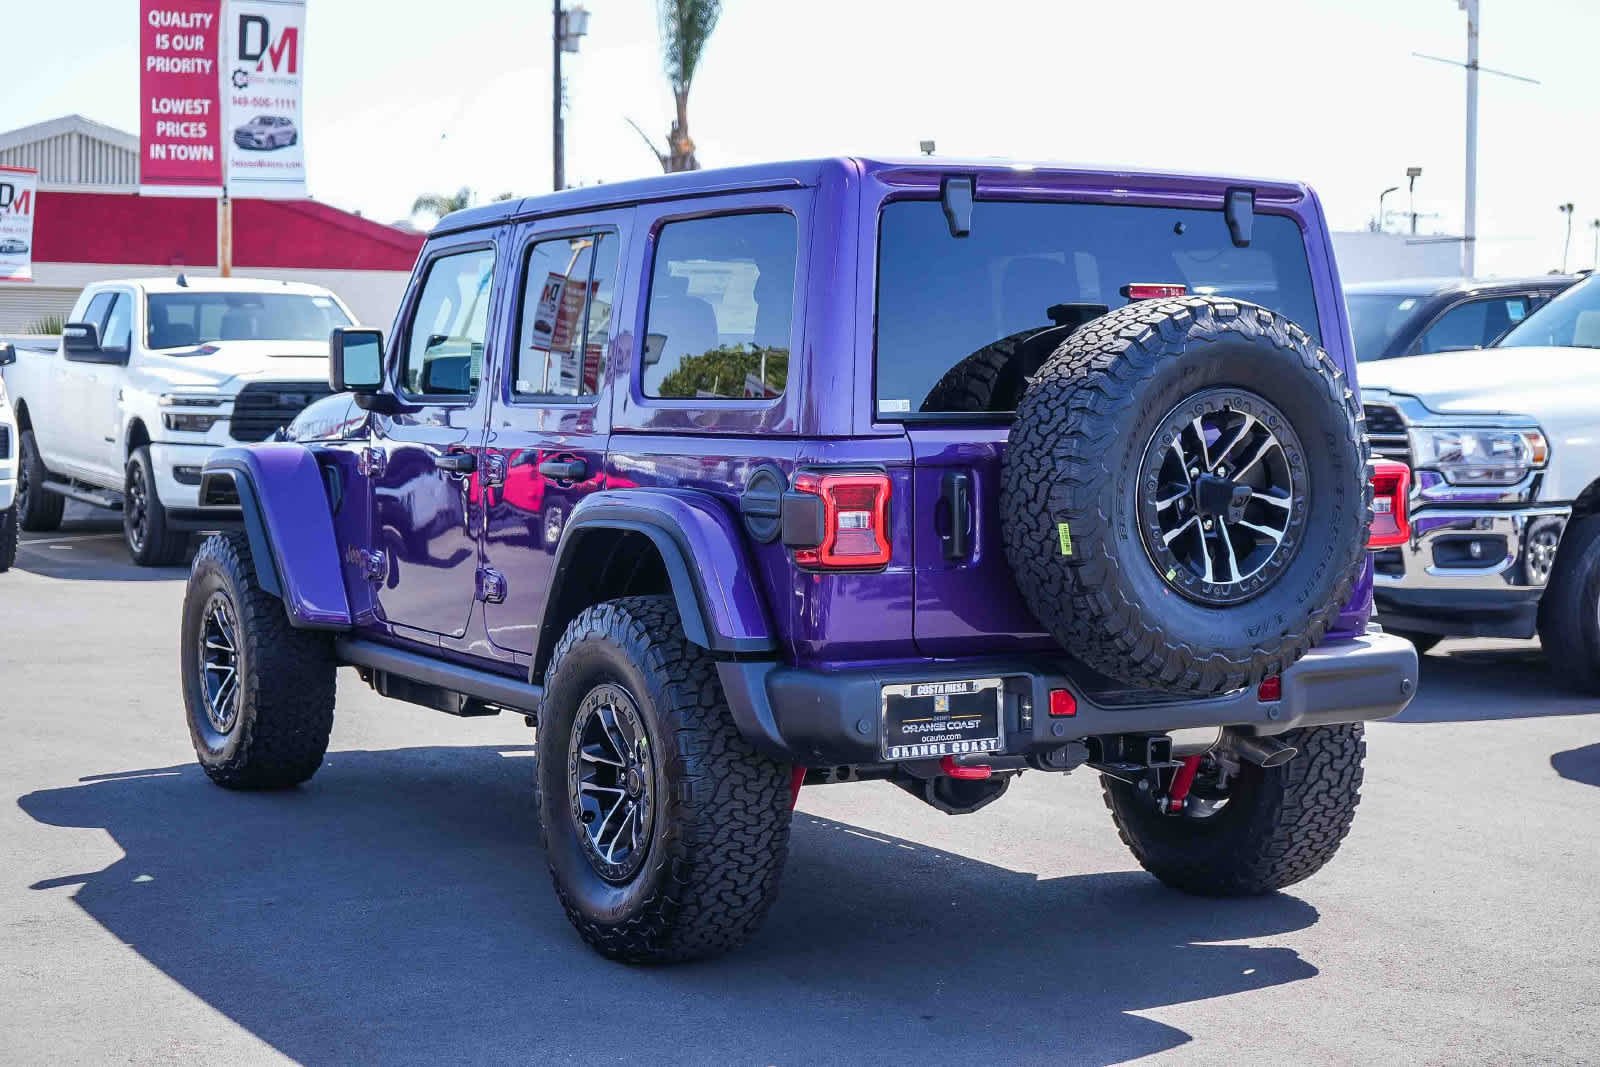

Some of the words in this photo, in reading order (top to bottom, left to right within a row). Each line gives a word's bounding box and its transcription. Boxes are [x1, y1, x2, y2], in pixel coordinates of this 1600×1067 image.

[149, 10, 213, 28] QUALITY
[155, 34, 170, 50] IS
[172, 35, 205, 50] OUR
[146, 56, 213, 75] PRIORITY
[151, 97, 211, 115] LOWEST
[156, 121, 207, 138] PRICES
[150, 144, 166, 160] IN
[169, 145, 214, 161] TOWN
[902, 722, 946, 734] ORANGE
[947, 720, 981, 730] COAST
[892, 743, 946, 758] ORANGE
[952, 740, 997, 753] COAST
